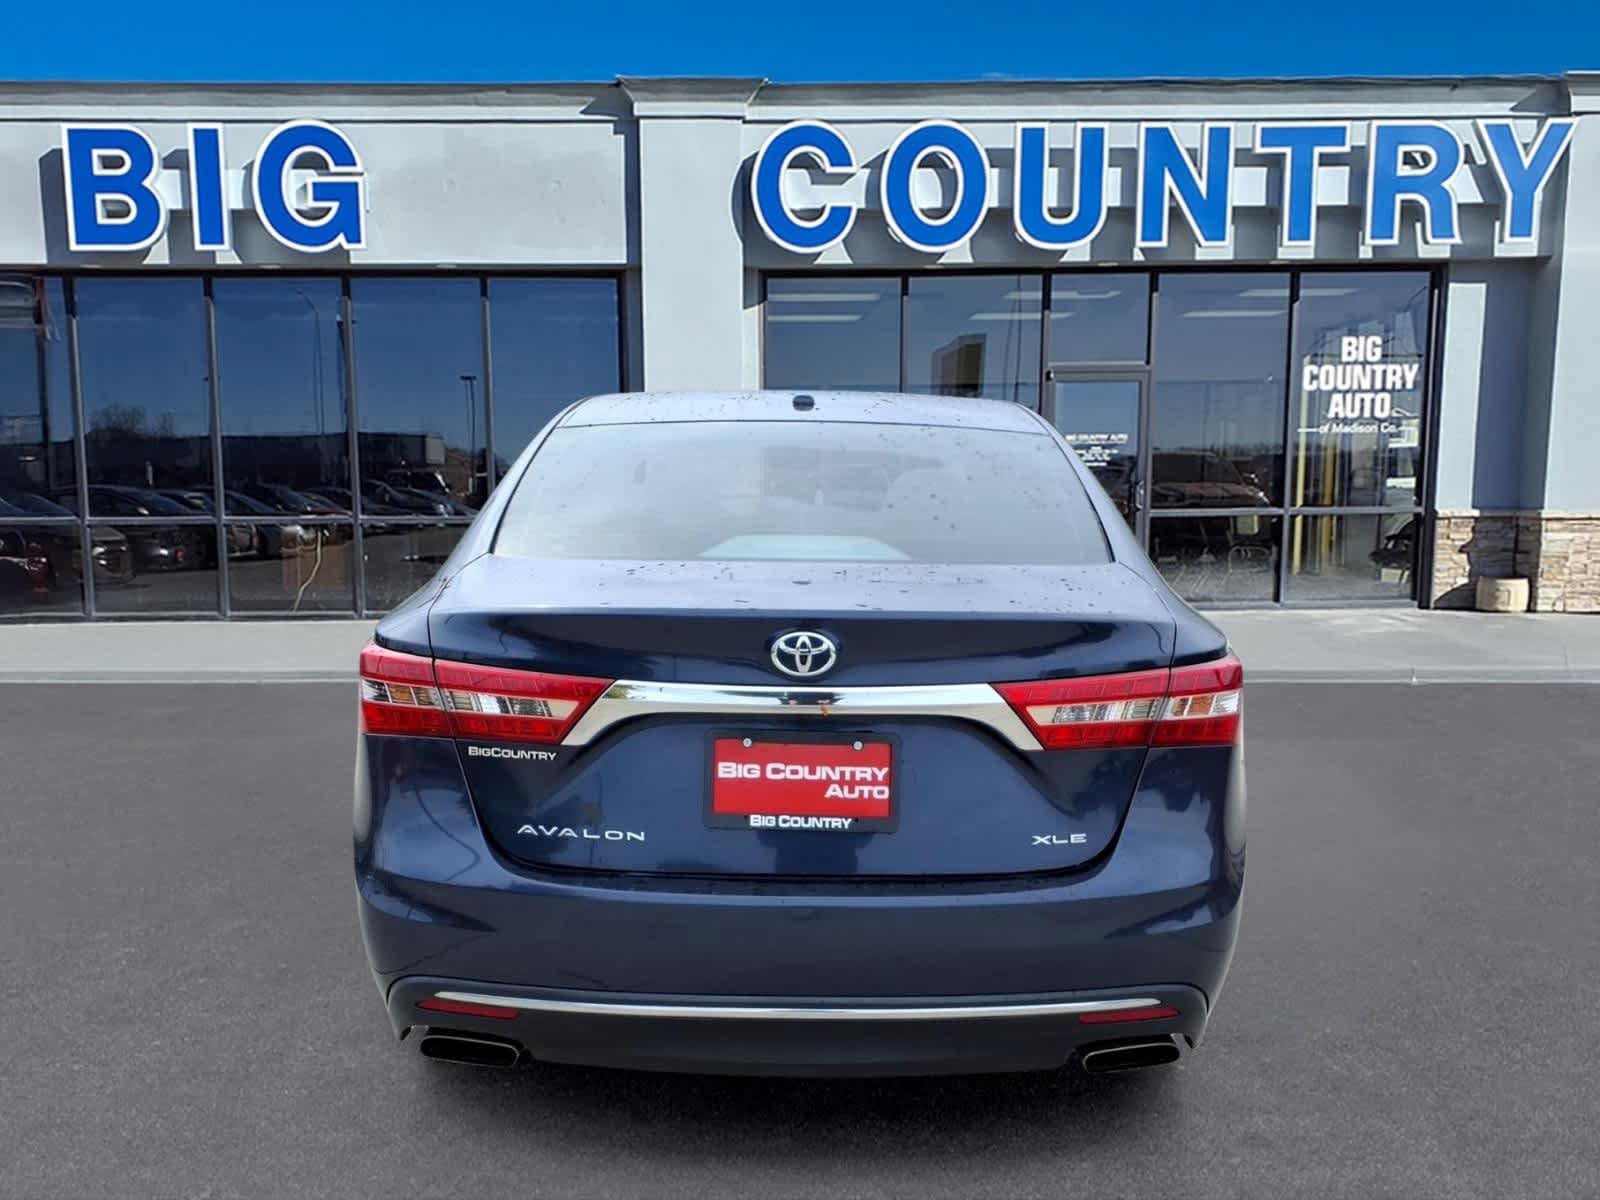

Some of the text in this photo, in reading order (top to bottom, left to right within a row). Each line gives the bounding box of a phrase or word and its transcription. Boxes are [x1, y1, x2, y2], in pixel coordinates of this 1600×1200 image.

[61, 118, 1575, 255] BIG COUNTRY
[1341, 335, 1382, 362] BIG
[1302, 363, 1419, 391] COUNTRY
[1327, 392, 1391, 418] AUTO
[717, 761, 889, 781] BIG COUNTRY
[824, 784, 889, 799] AUTO
[749, 814, 852, 829] BIG COUNTRY
[517, 824, 646, 841] AVALON
[1031, 833, 1087, 845] XLE
